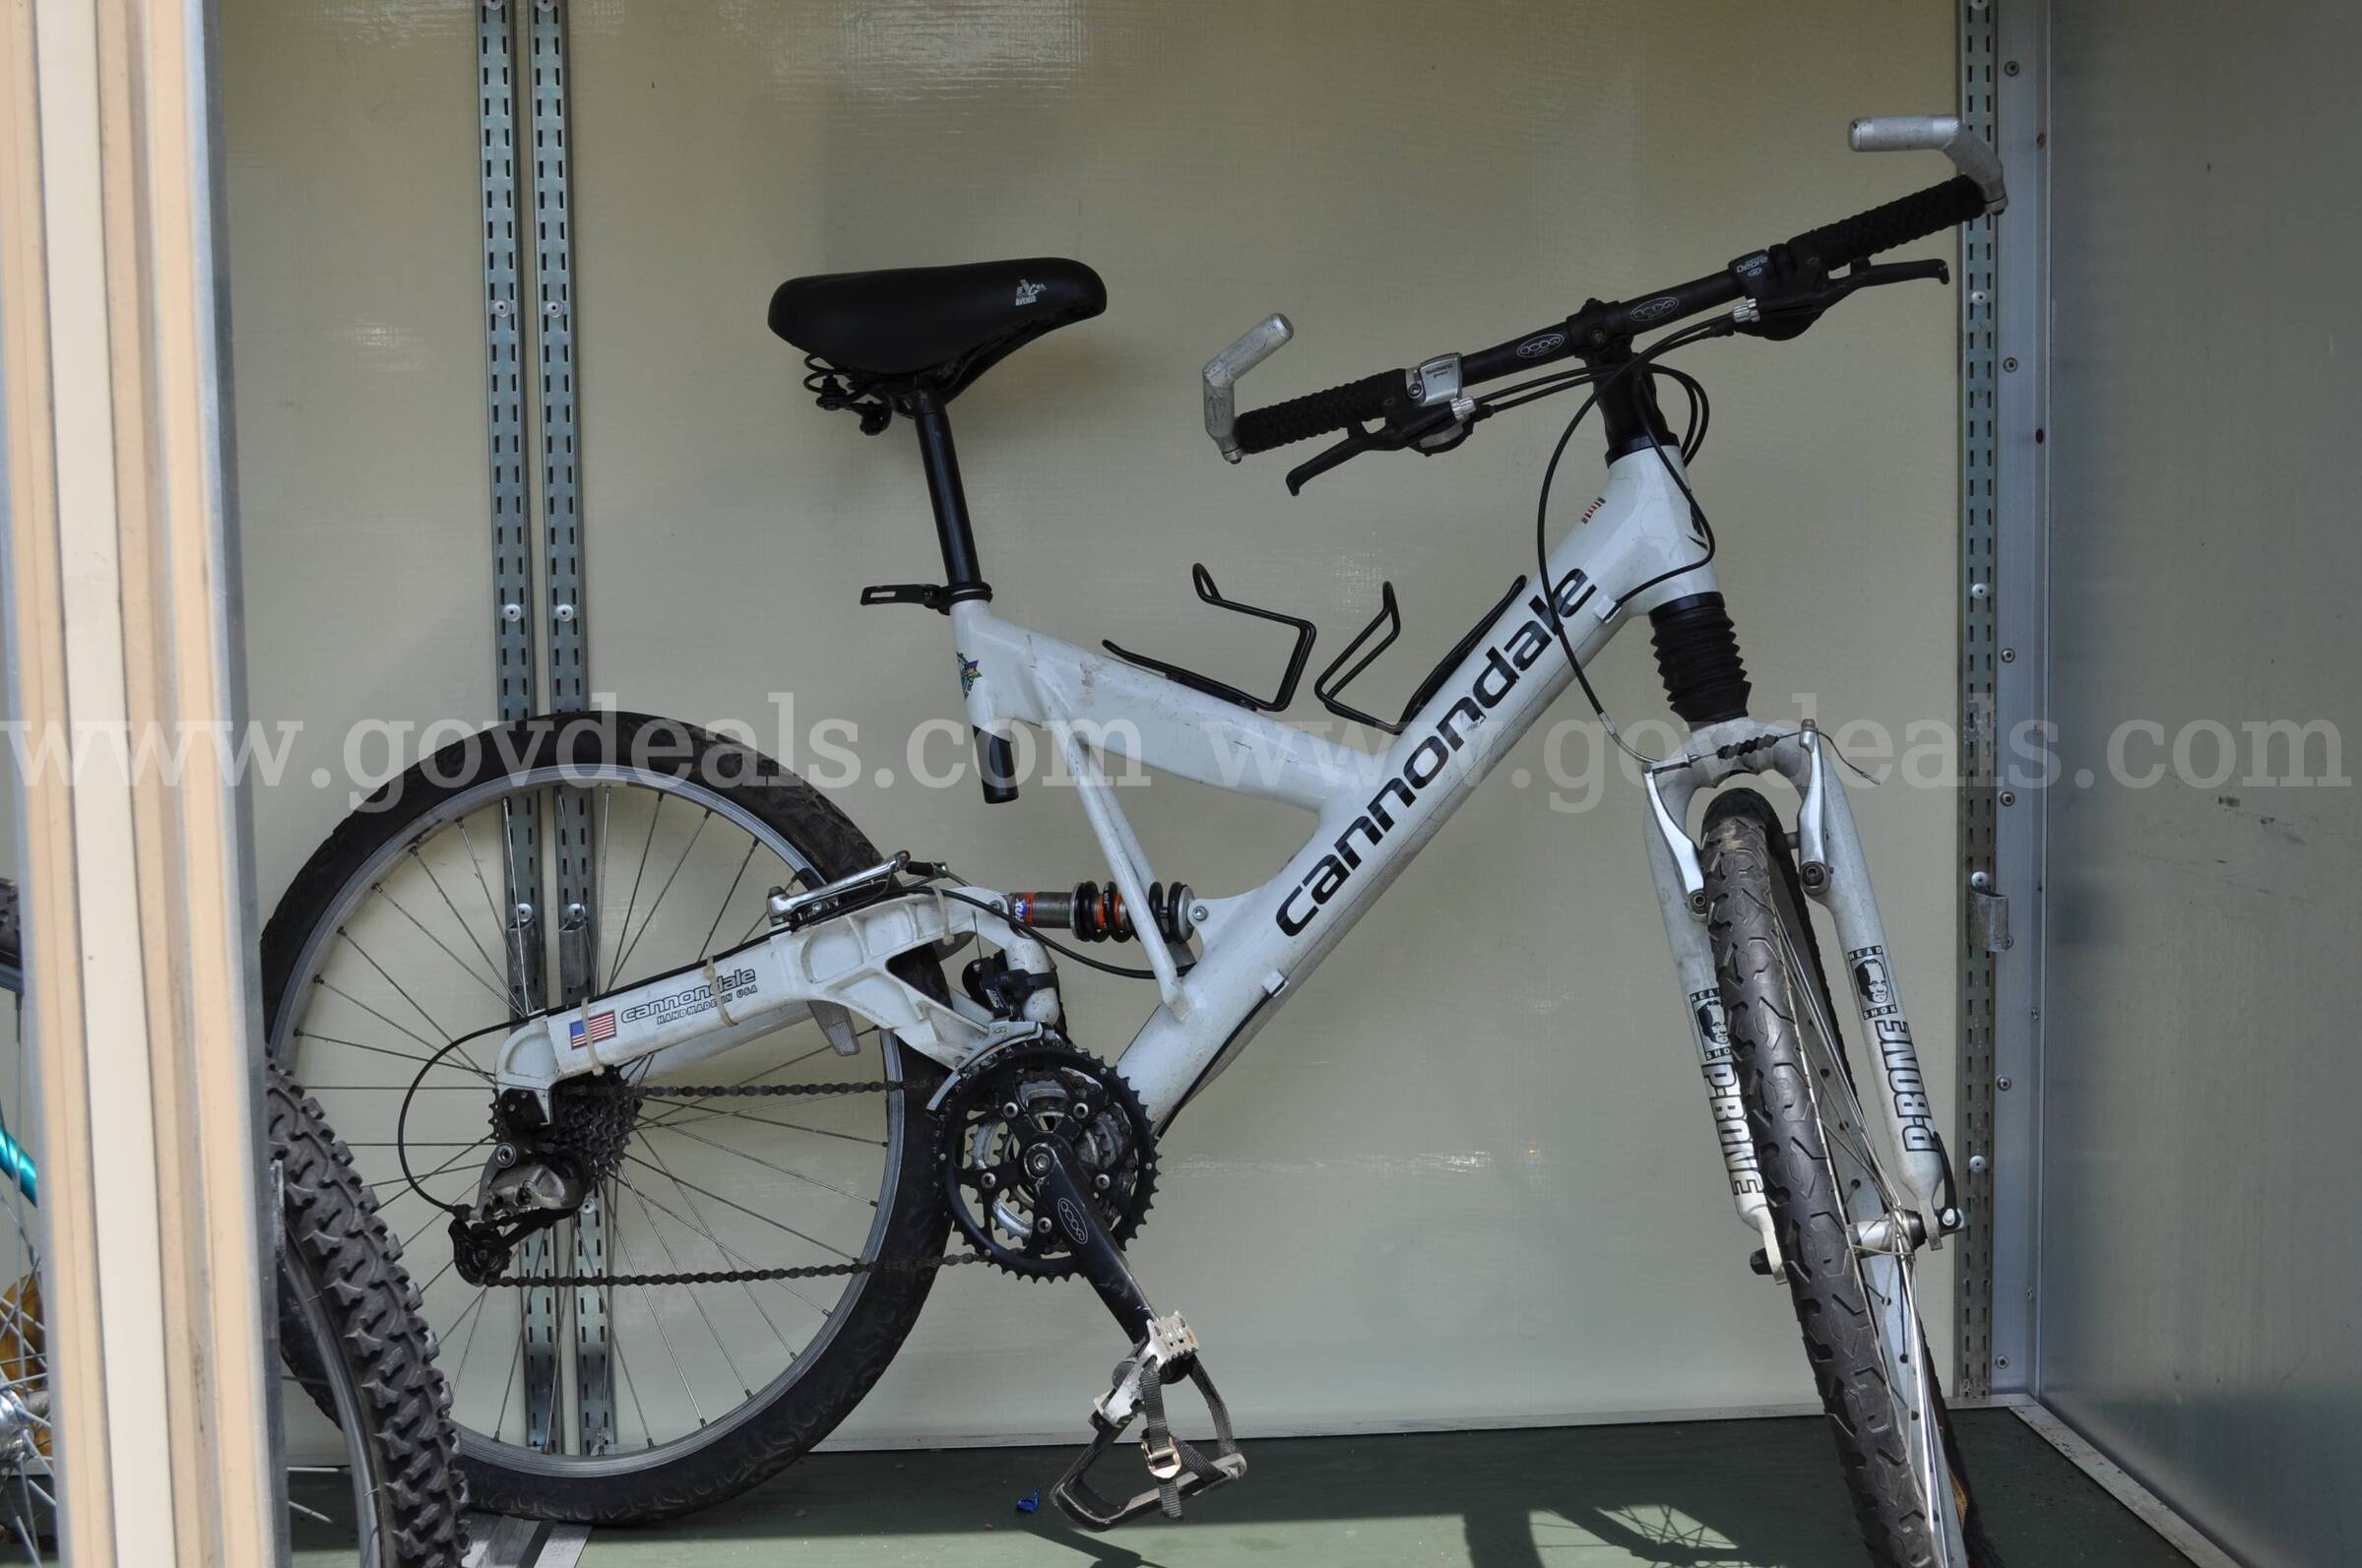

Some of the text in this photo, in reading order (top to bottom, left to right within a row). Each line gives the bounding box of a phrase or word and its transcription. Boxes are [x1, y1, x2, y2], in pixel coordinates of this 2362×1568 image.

[1276, 568, 1597, 937] cannondale
[1848, 946, 1883, 960] HEAD
[657, 1000, 718, 1025] HANDMADE
[736, 984, 757, 998] USA
[1691, 988, 1720, 1002] HEA
[1863, 1005, 1897, 1020] SHOK
[1705, 1047, 1731, 1060] SHO
[1875, 1019, 1939, 1152] P-BONE
[1701, 1063, 1764, 1195] P-BONE
